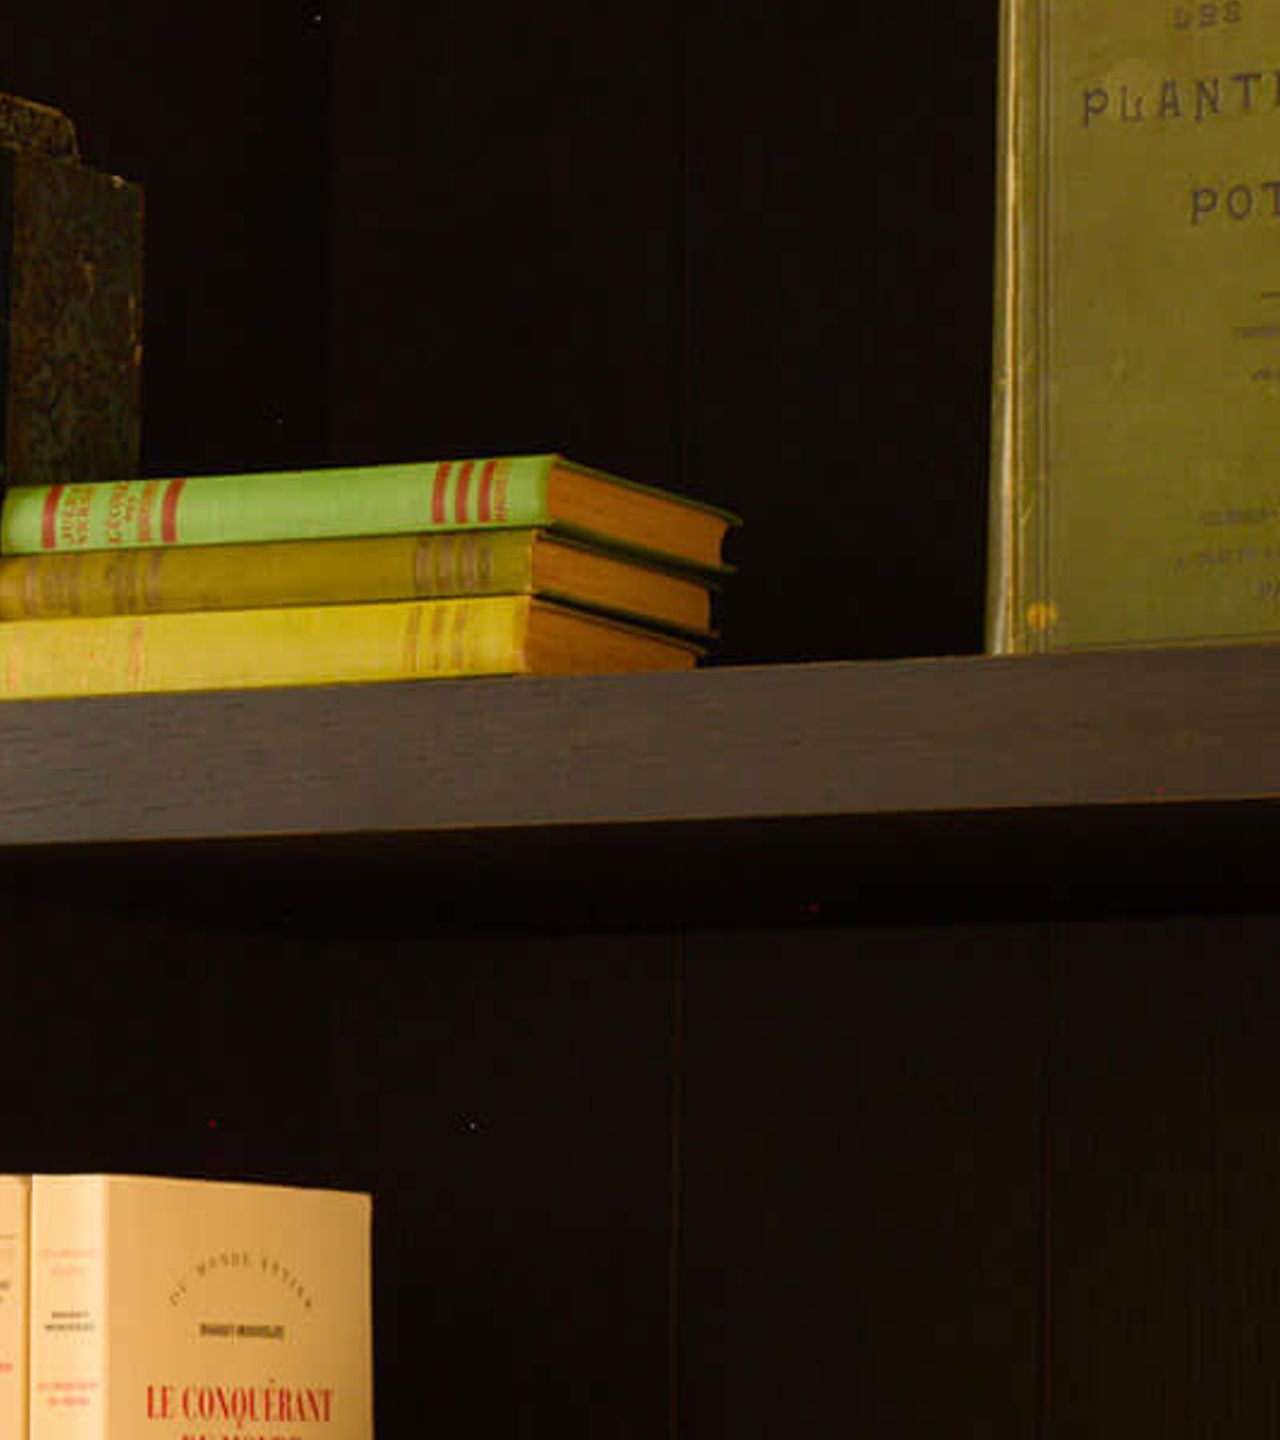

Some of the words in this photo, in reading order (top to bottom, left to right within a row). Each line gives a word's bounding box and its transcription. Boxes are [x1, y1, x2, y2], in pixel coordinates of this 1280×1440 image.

[1083, 72, 1280, 128] PLANT
[147, 1384, 173, 1420] LE
[181, 1377, 333, 1429] CONQUÉRANT
